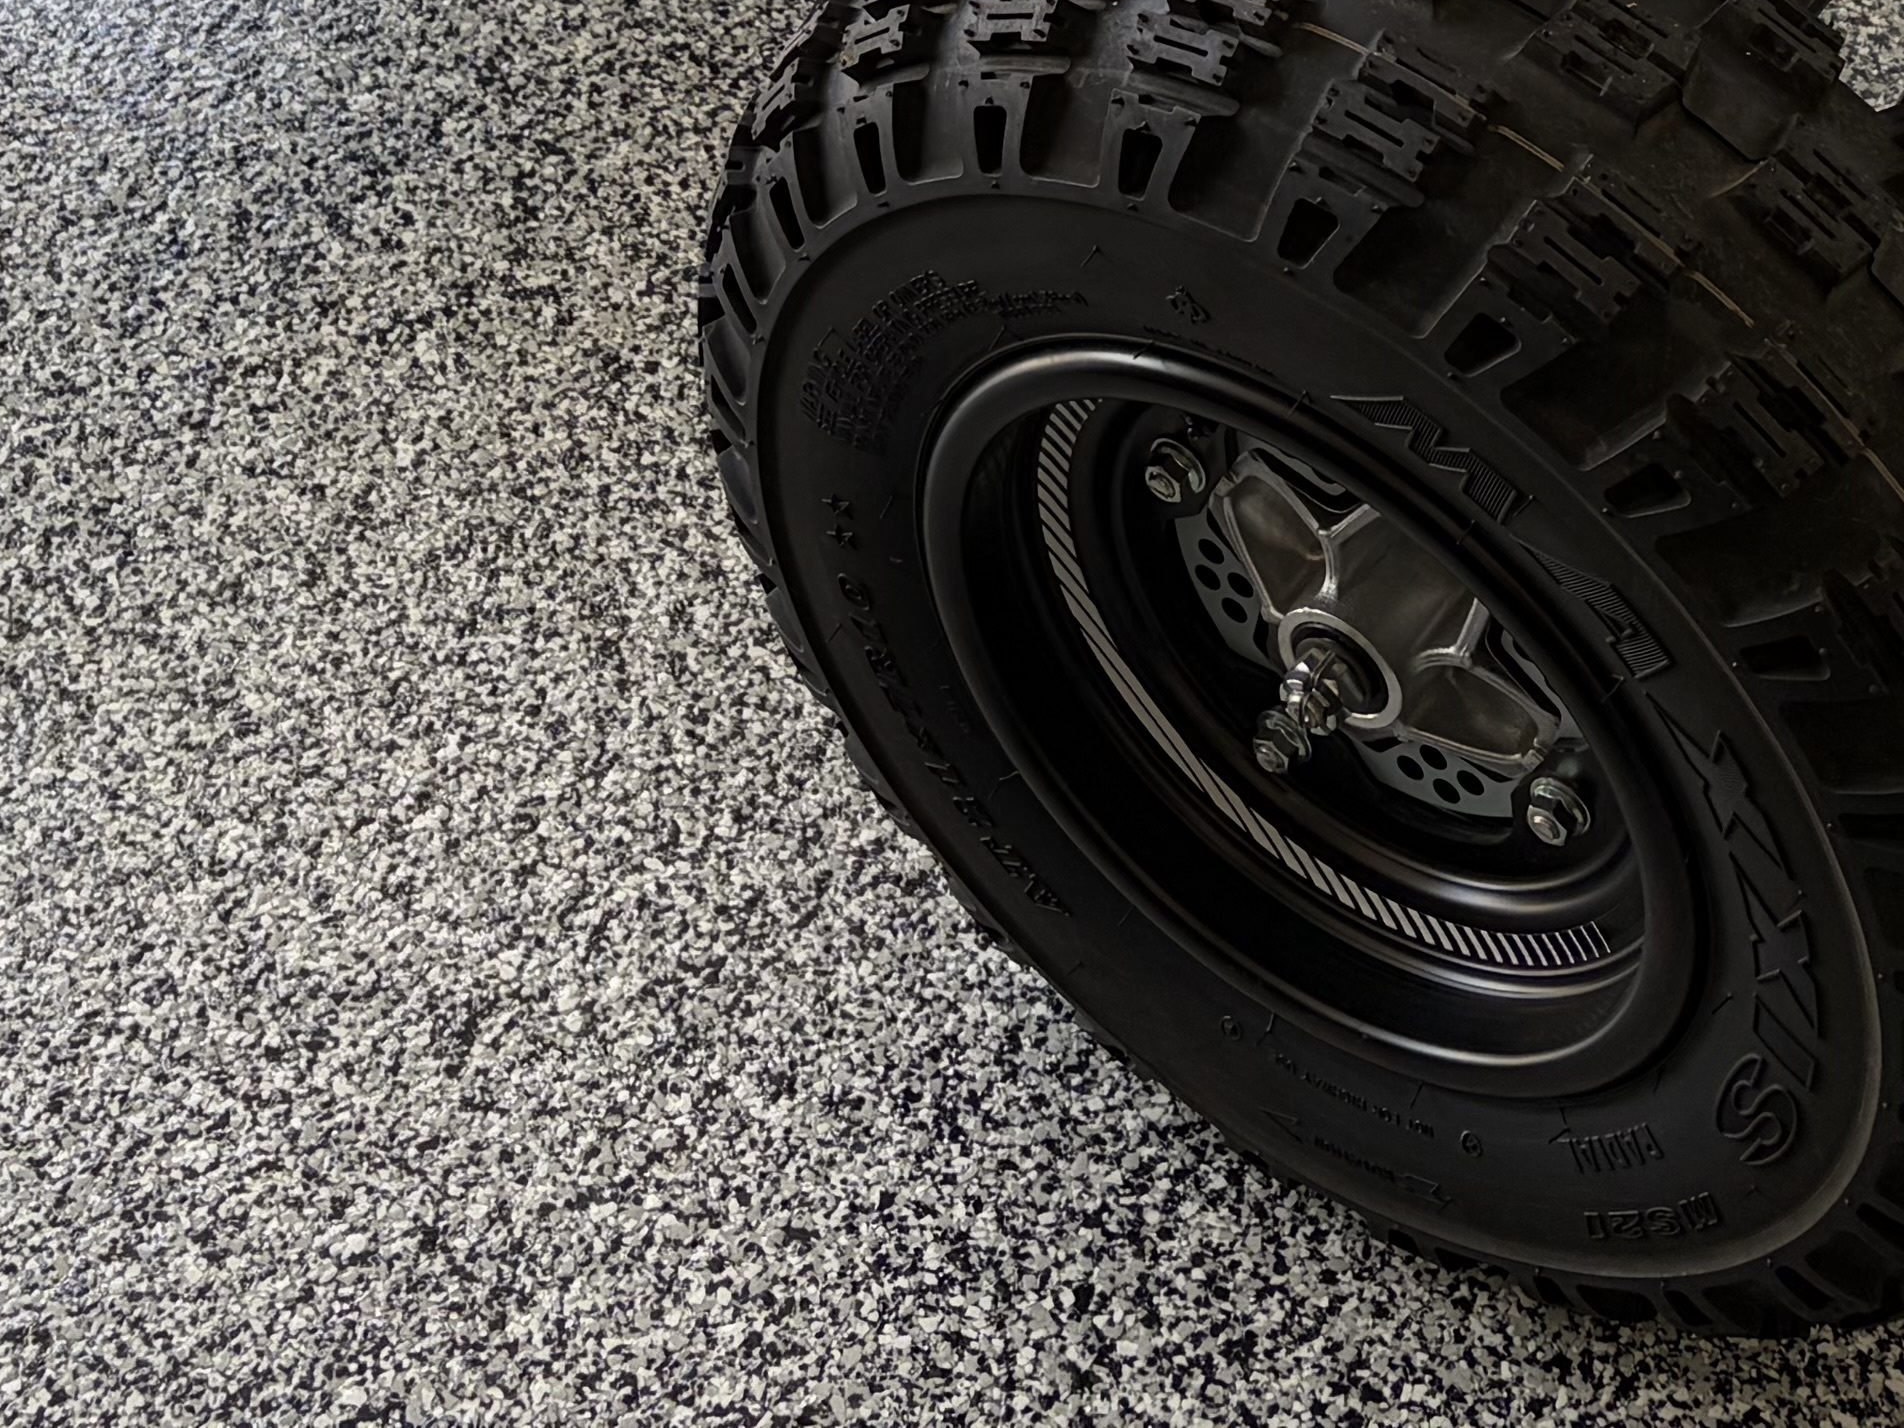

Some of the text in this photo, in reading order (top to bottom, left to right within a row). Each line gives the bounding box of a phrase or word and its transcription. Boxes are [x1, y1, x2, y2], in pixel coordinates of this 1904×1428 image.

[1328, 393, 1822, 1166] MAXXIS
[1557, 1122, 1666, 1176] RADIAL
[1582, 1190, 1723, 1241] MS21
